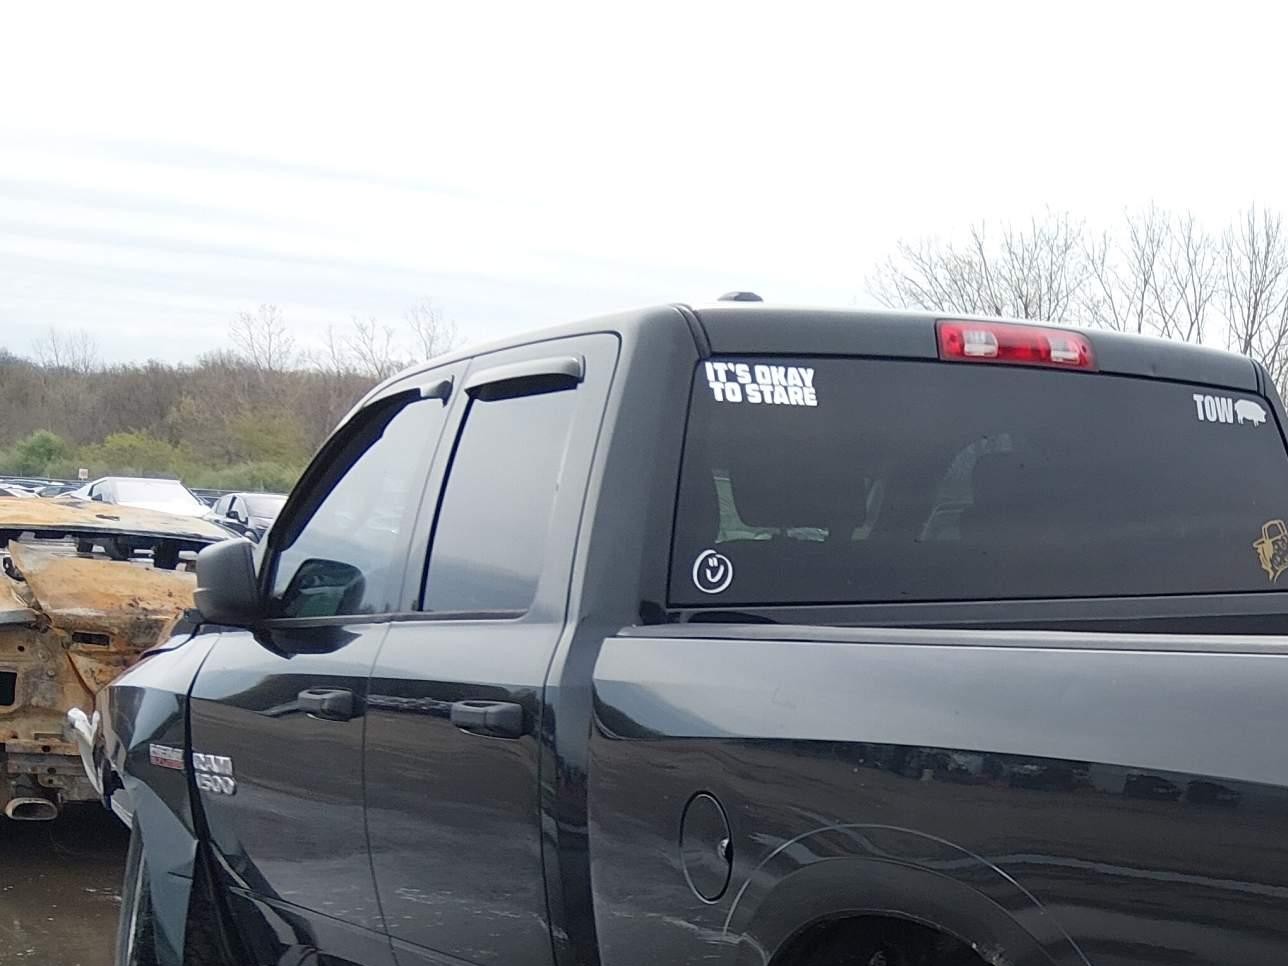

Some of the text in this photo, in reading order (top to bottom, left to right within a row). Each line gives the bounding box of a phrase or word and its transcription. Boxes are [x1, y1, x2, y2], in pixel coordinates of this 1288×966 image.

[705, 362, 814, 387] IT'S OKAY
[709, 381, 818, 406] TO STARE
[1193, 394, 1234, 424] TOW
